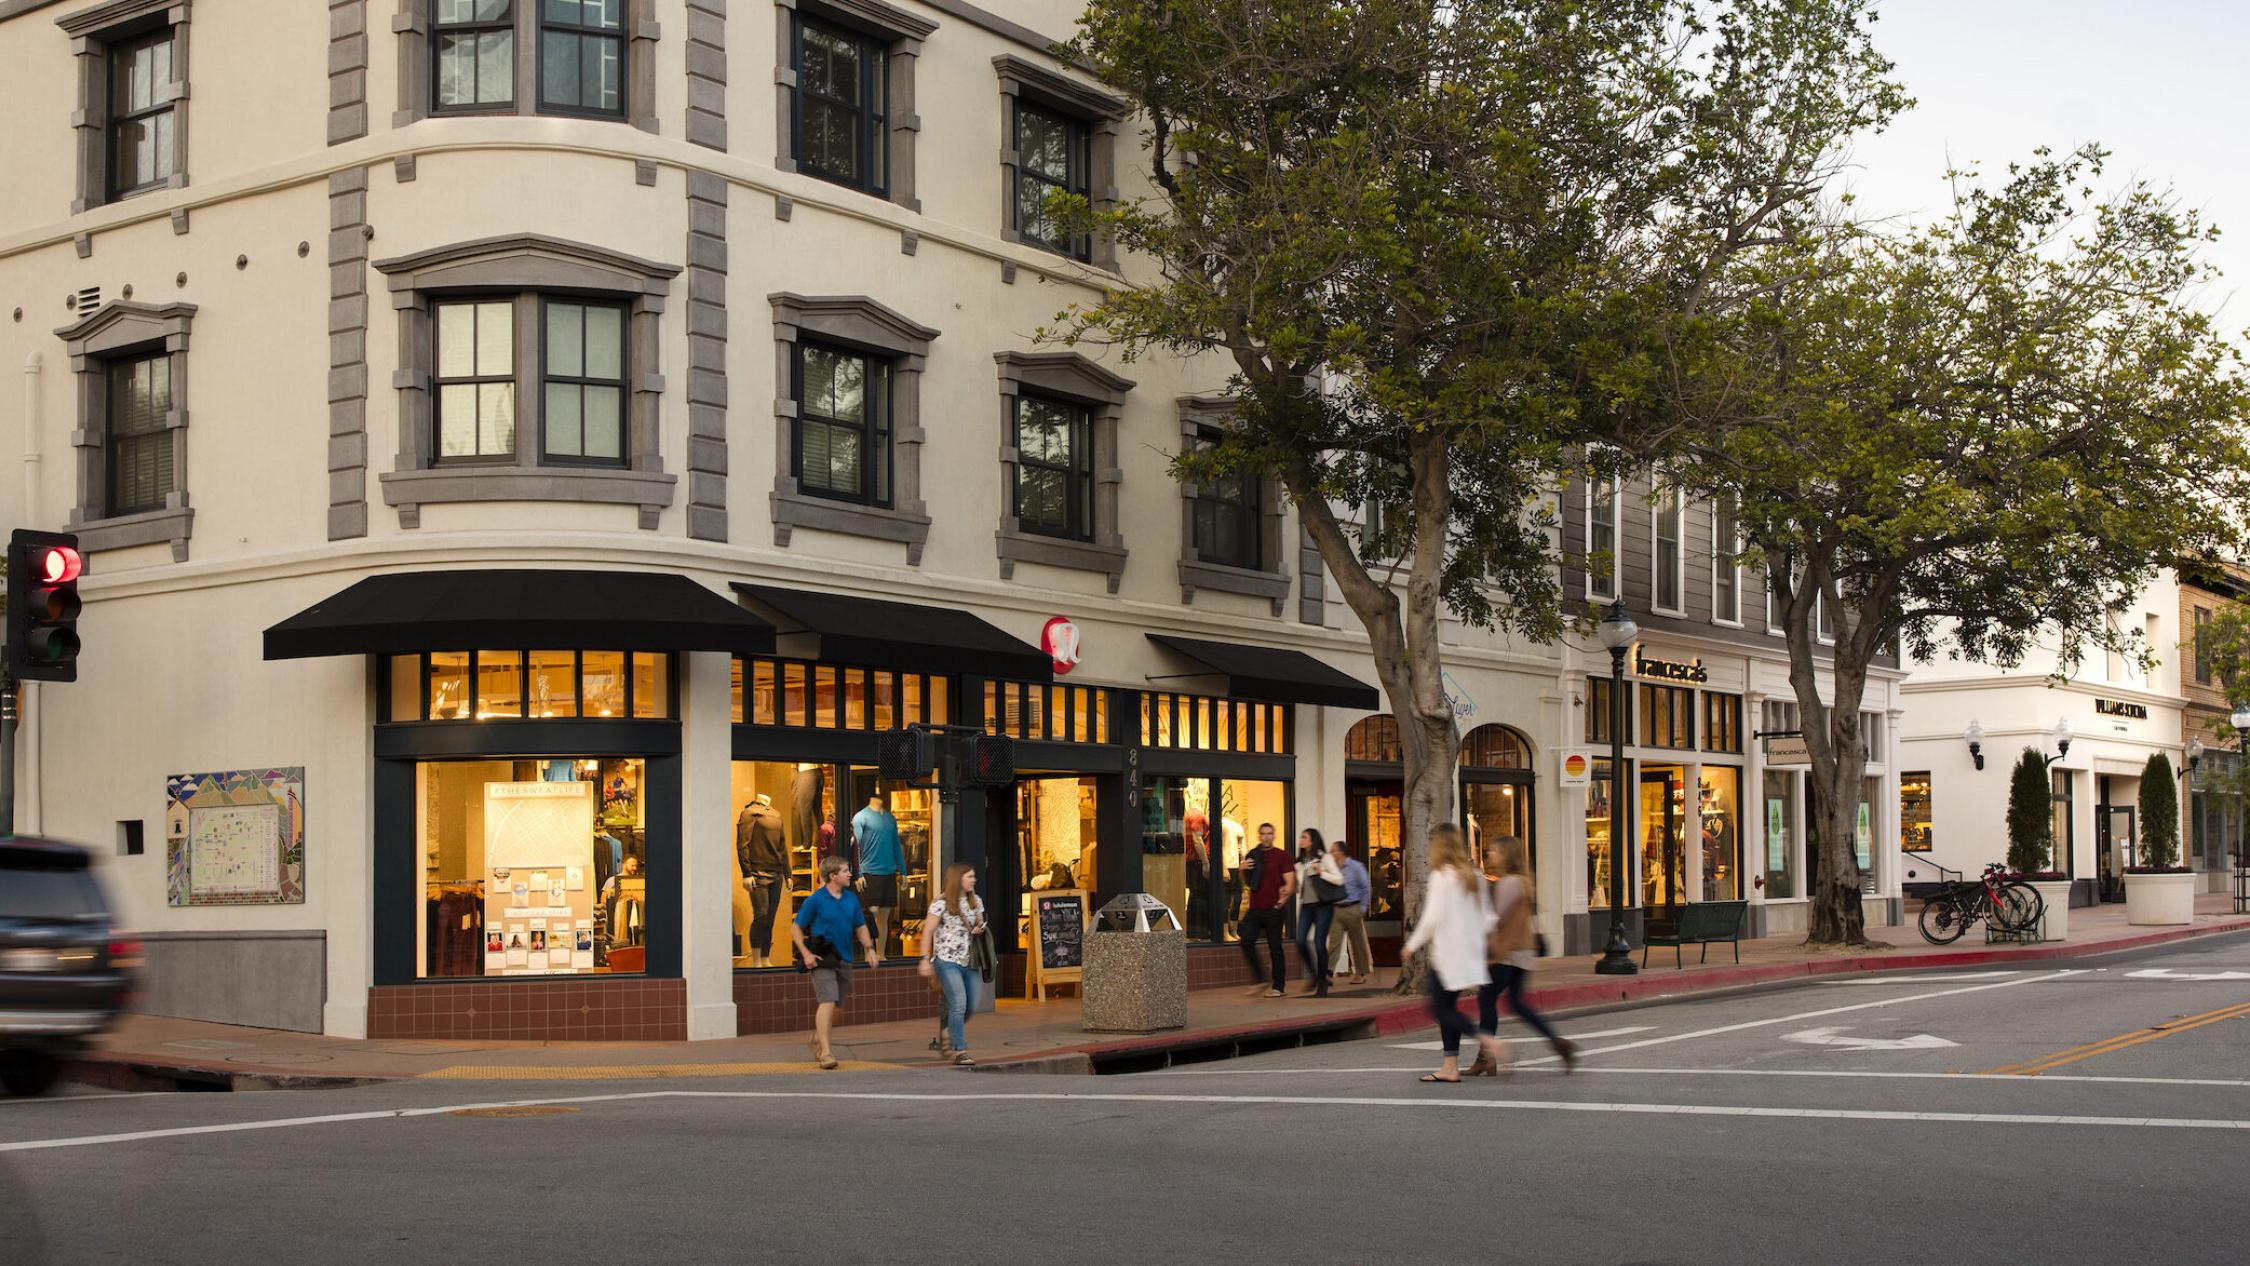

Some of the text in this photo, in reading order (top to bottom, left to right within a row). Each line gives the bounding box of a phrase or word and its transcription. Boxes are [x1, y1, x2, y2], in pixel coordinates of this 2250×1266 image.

[1636, 644, 1708, 683] francesca's
[1768, 747, 1808, 755] francesca
[1129, 748, 1137, 808] 840
